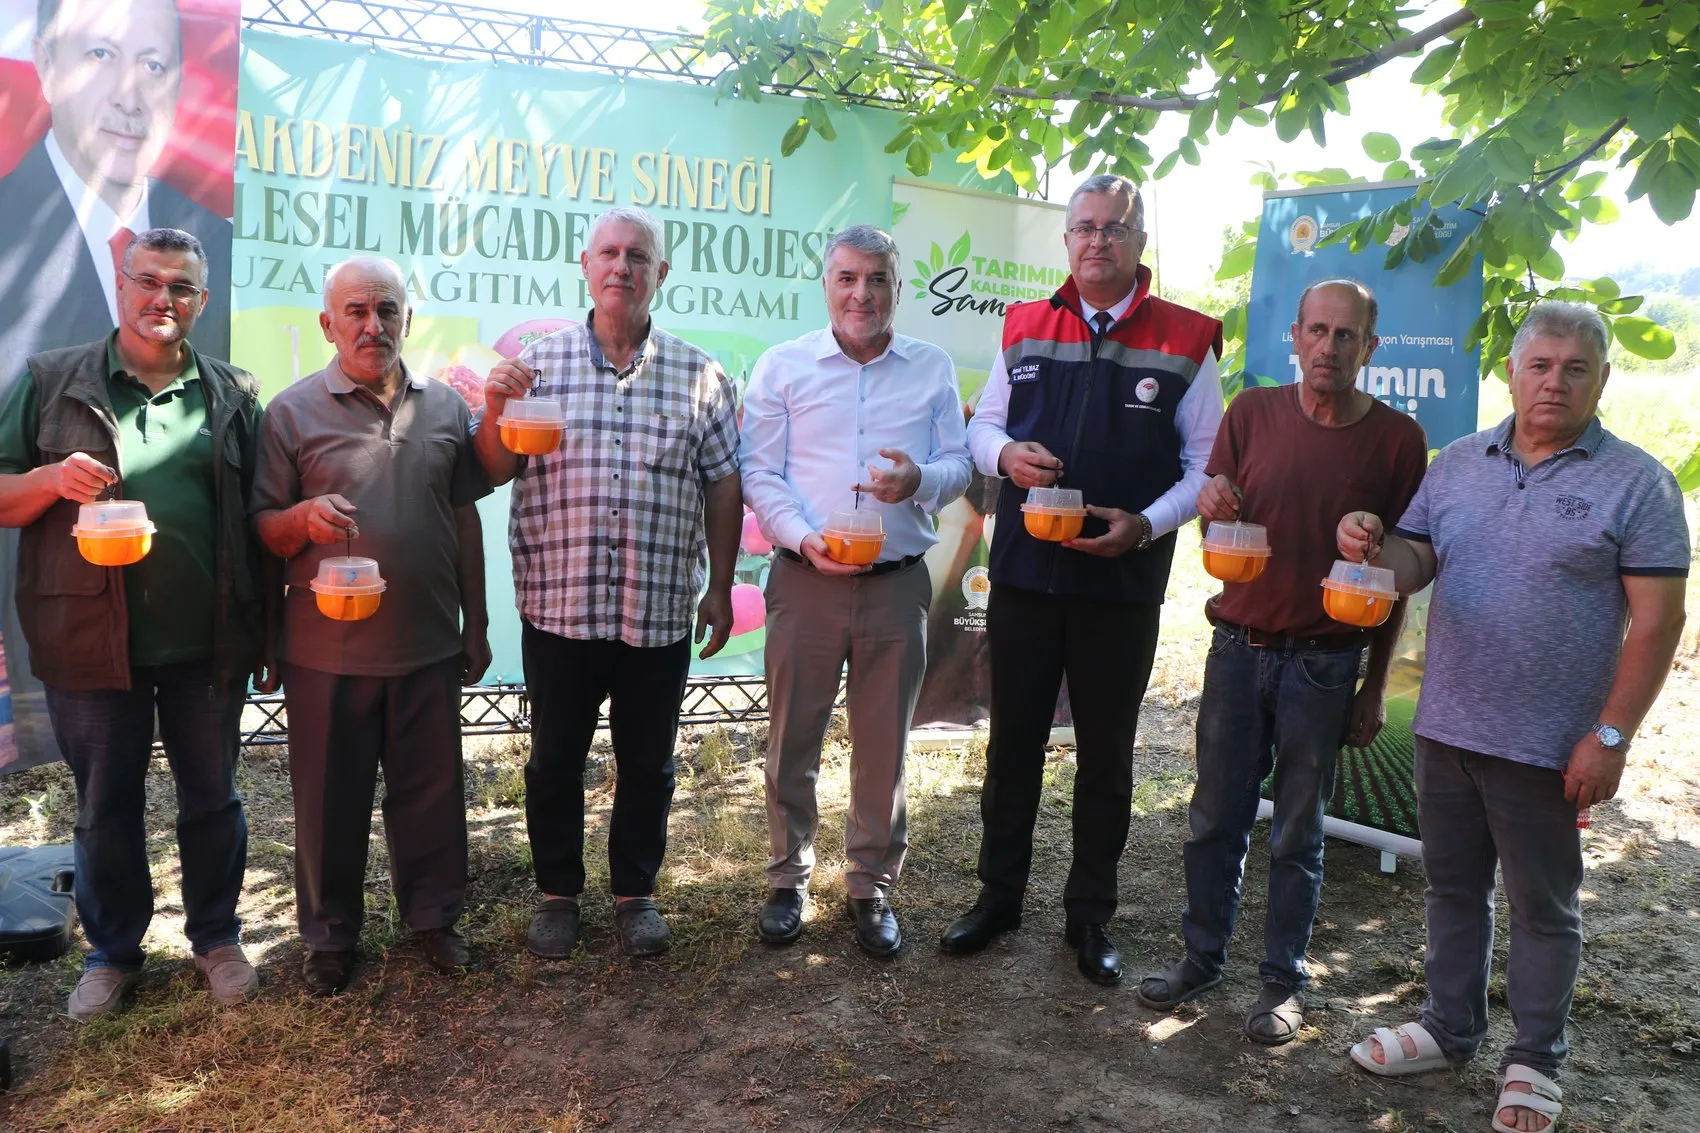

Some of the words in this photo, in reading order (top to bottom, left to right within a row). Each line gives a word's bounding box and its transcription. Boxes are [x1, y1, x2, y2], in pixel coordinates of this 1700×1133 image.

[235, 109, 448, 191] AKDENİZ
[463, 135, 616, 202] MEYVE
[630, 147, 773, 215] SİNEĞİ
[399, 195, 600, 265] MÜCADE
[406, 263, 565, 307] AĞITIM
[577, 279, 800, 320] PGRAMI
[928, 266, 1023, 317] Sam
[1400, 334, 1453, 348] Yarışması
[1555, 496, 1576, 507] WEST
[1577, 501, 1592, 511] SIDE
